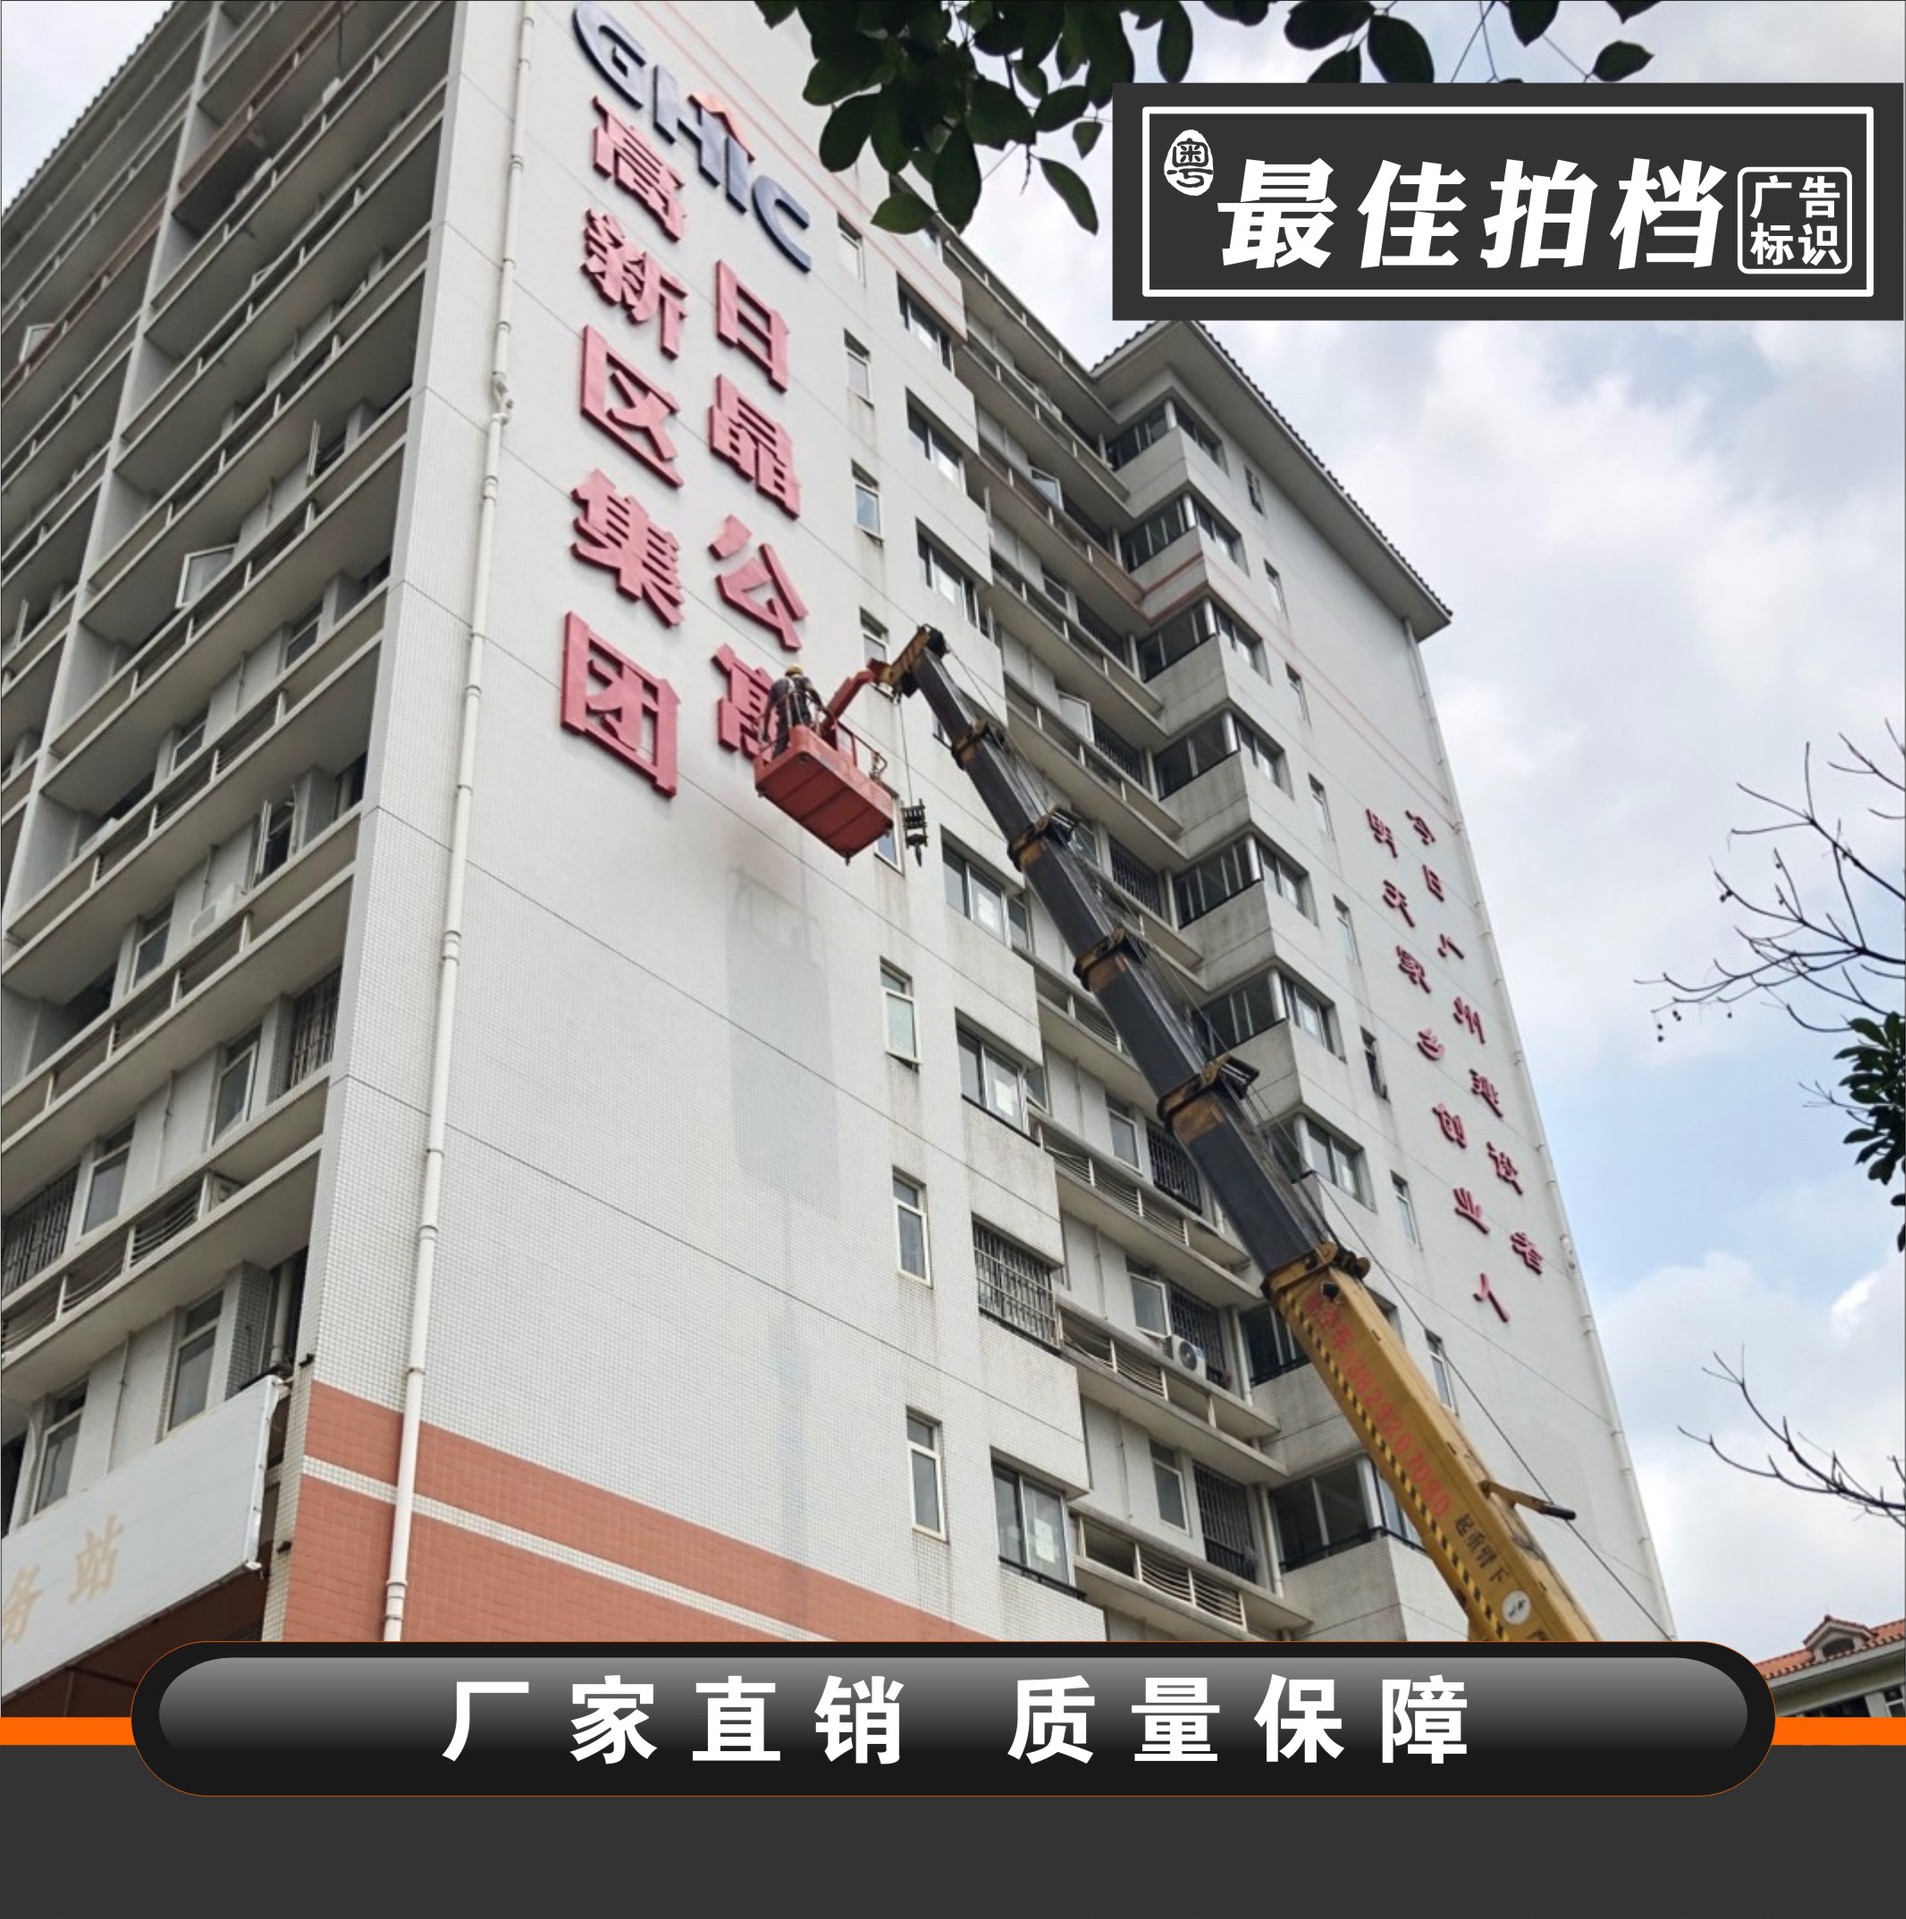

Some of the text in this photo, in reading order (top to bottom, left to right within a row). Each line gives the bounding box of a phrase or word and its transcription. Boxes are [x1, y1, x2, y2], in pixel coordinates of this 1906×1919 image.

[572, 1, 812, 273] GHIC
[561, 95, 688, 798] 高新区集团
[708, 258, 808, 766] 日晶公寓
